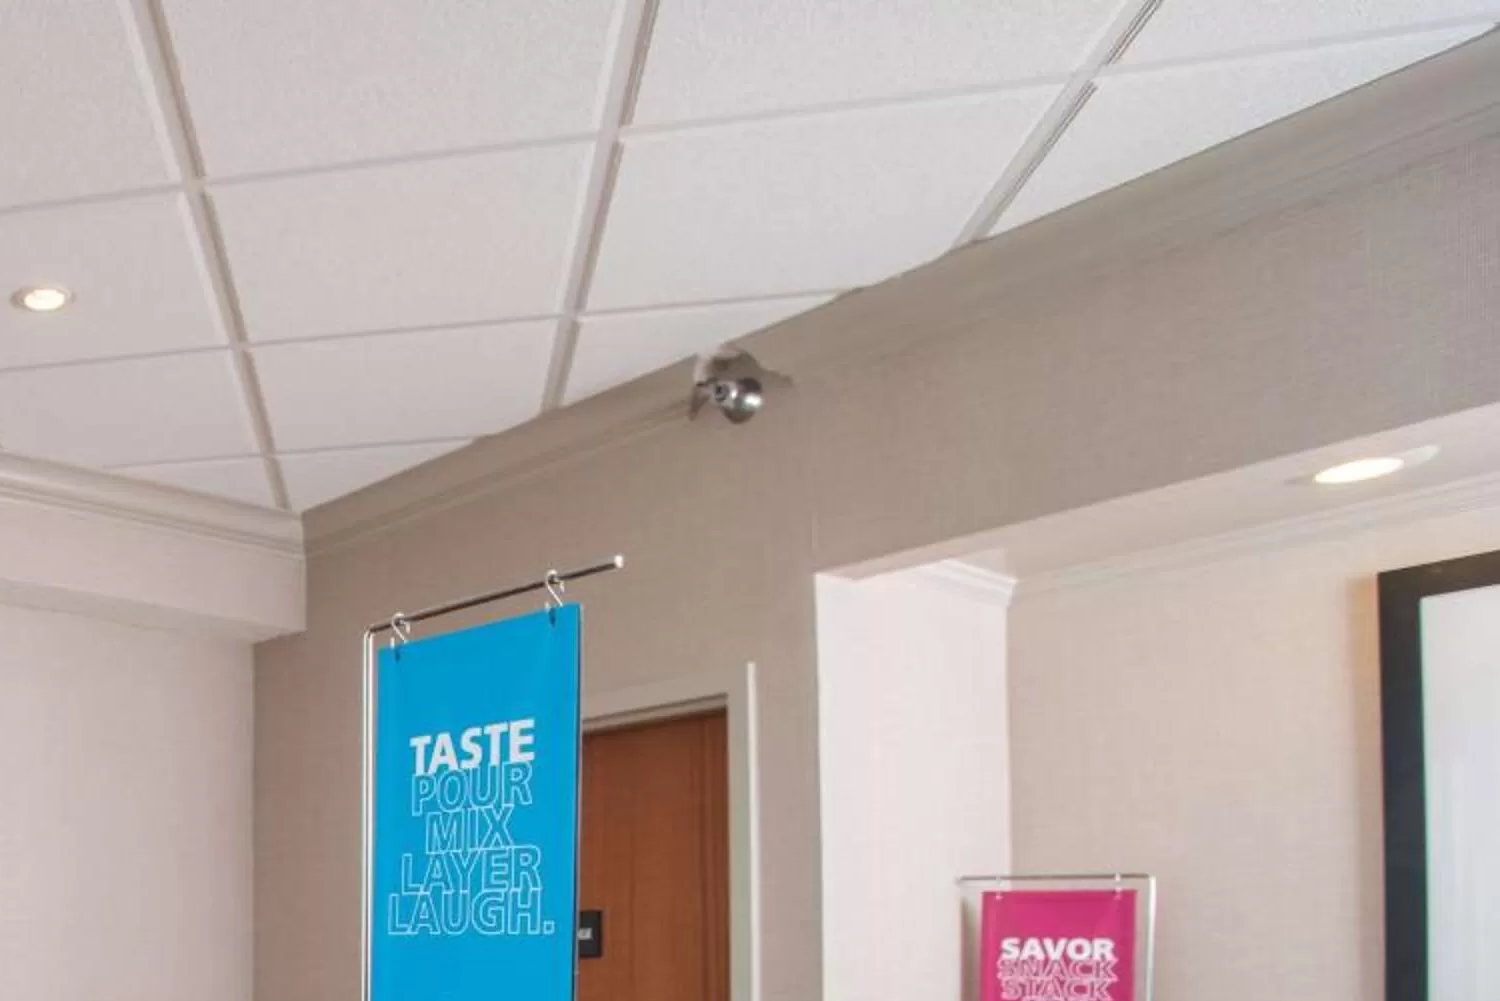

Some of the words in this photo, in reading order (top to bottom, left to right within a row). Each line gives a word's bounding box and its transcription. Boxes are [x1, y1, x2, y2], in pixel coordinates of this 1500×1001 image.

[409, 718, 536, 776] TASTE
[411, 762, 533, 816] POUR
[425, 804, 516, 854] MIX
[401, 845, 542, 895] LAYER
[387, 888, 555, 935] LAUGH.
[996, 957, 1118, 982] SNACK
[1000, 937, 1116, 960] SAVOR
